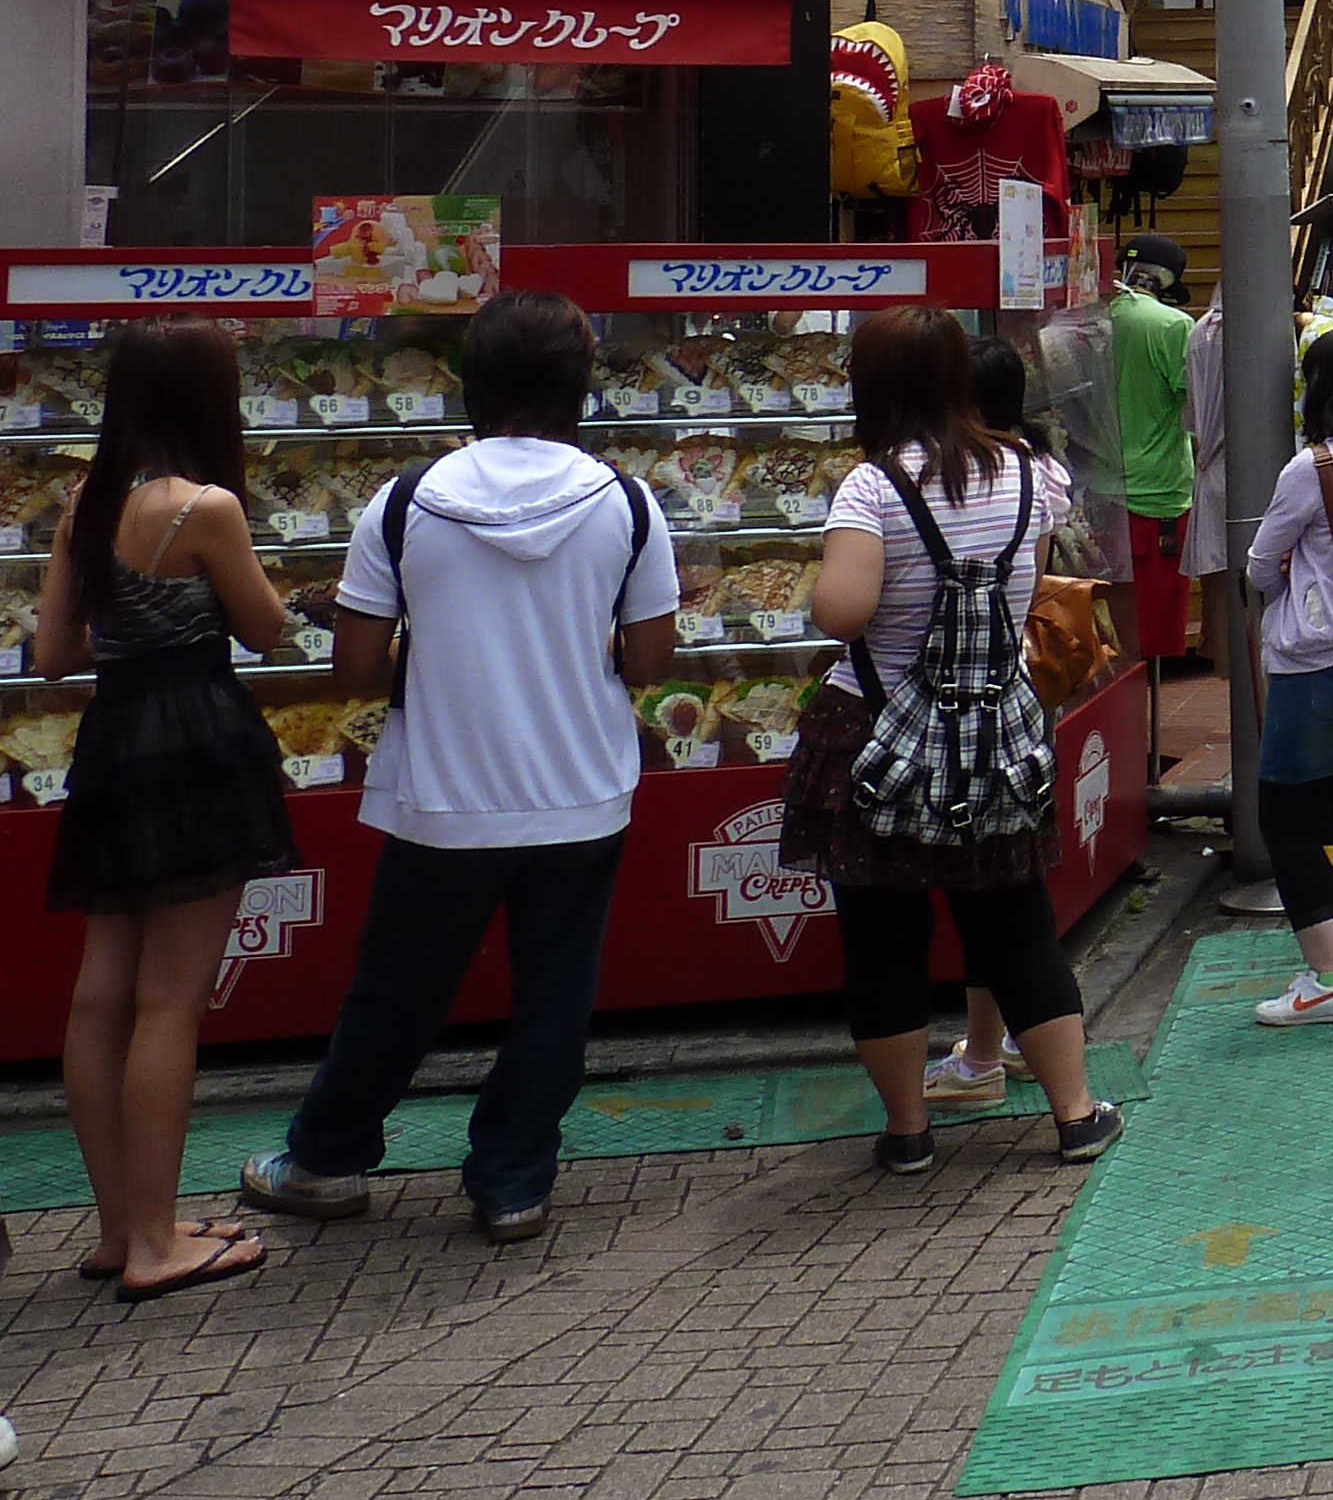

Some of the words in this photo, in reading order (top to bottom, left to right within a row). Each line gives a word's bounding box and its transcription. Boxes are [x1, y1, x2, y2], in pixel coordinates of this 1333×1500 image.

[369, 1, 682, 49] マリオンクレープ
[119, 267, 312, 299] マリオンクレ
[662, 262, 891, 293] マリオンクレープ
[800, 387, 818, 402] 78
[318, 399, 338, 414] 66
[394, 397, 413, 412] 58
[783, 499, 801, 514] 22
[278, 516, 298, 531] 51
[678, 616, 696, 632] 45
[757, 614, 776, 629] 79
[303, 633, 323, 649] 56
[673, 740, 693, 757] 41
[754, 735, 773, 751] 59
[291, 760, 312, 776] 37
[33, 775, 54, 792] 34
[732, 804, 786, 836] PATIS
[739, 872, 829, 910] CREPES
